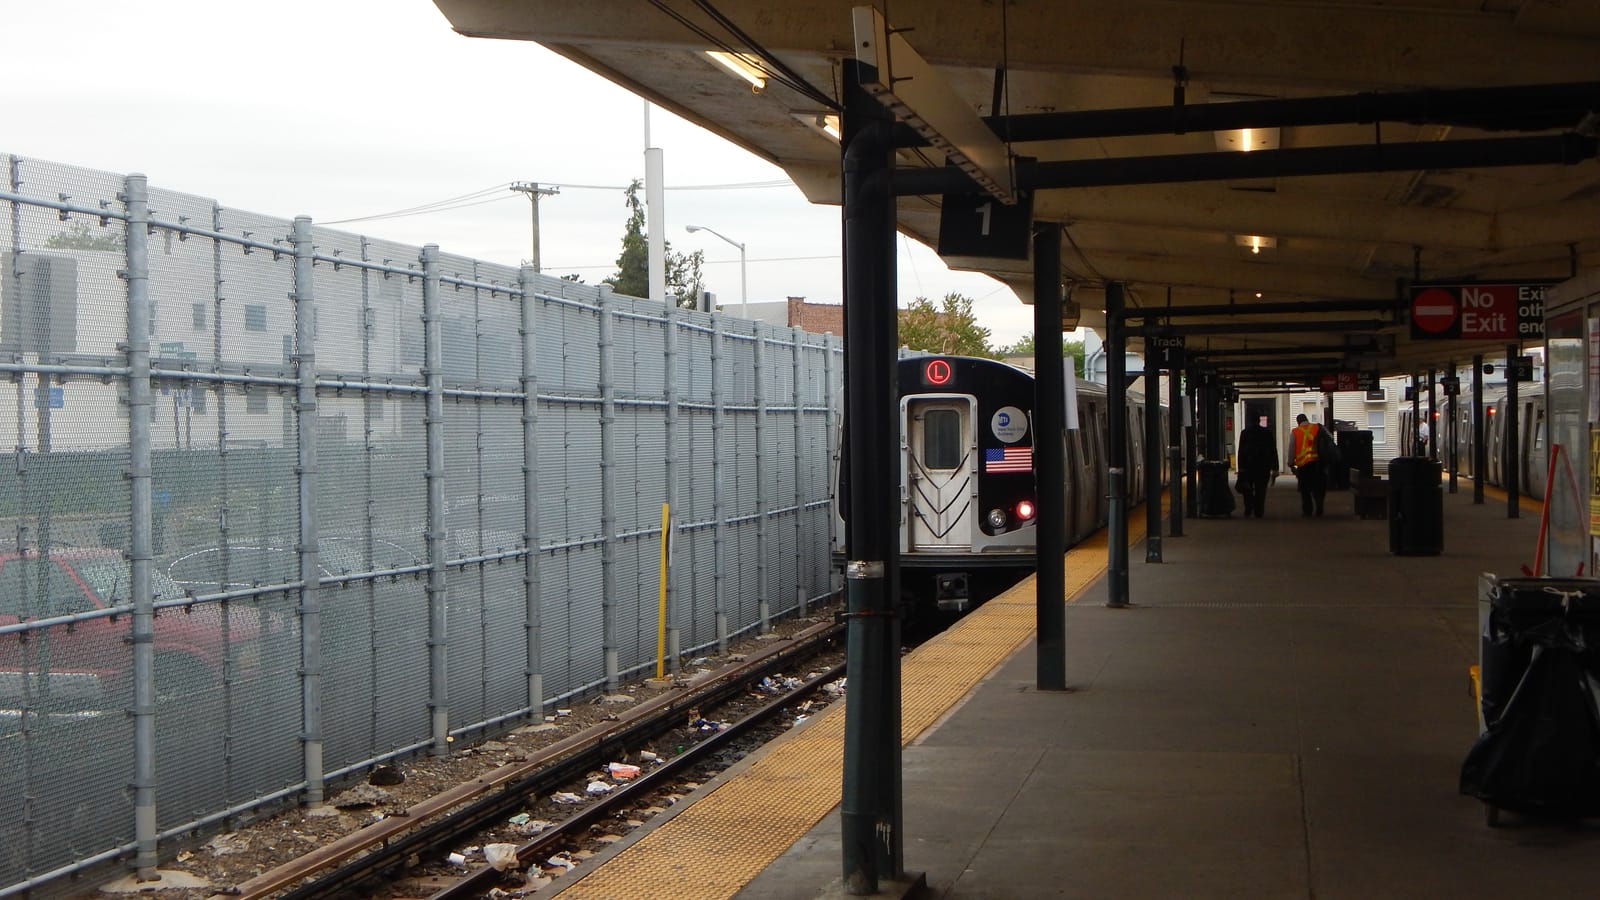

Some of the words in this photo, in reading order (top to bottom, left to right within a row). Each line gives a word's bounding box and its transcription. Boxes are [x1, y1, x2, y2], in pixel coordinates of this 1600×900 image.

[975, 202, 992, 236] 1
[1461, 287, 1495, 308] No
[1518, 286, 1544, 301] Exi
[1518, 302, 1544, 318] oth
[1461, 312, 1507, 333] Exit
[1152, 336, 1183, 347] Track
[1162, 348, 1169, 362] 1
